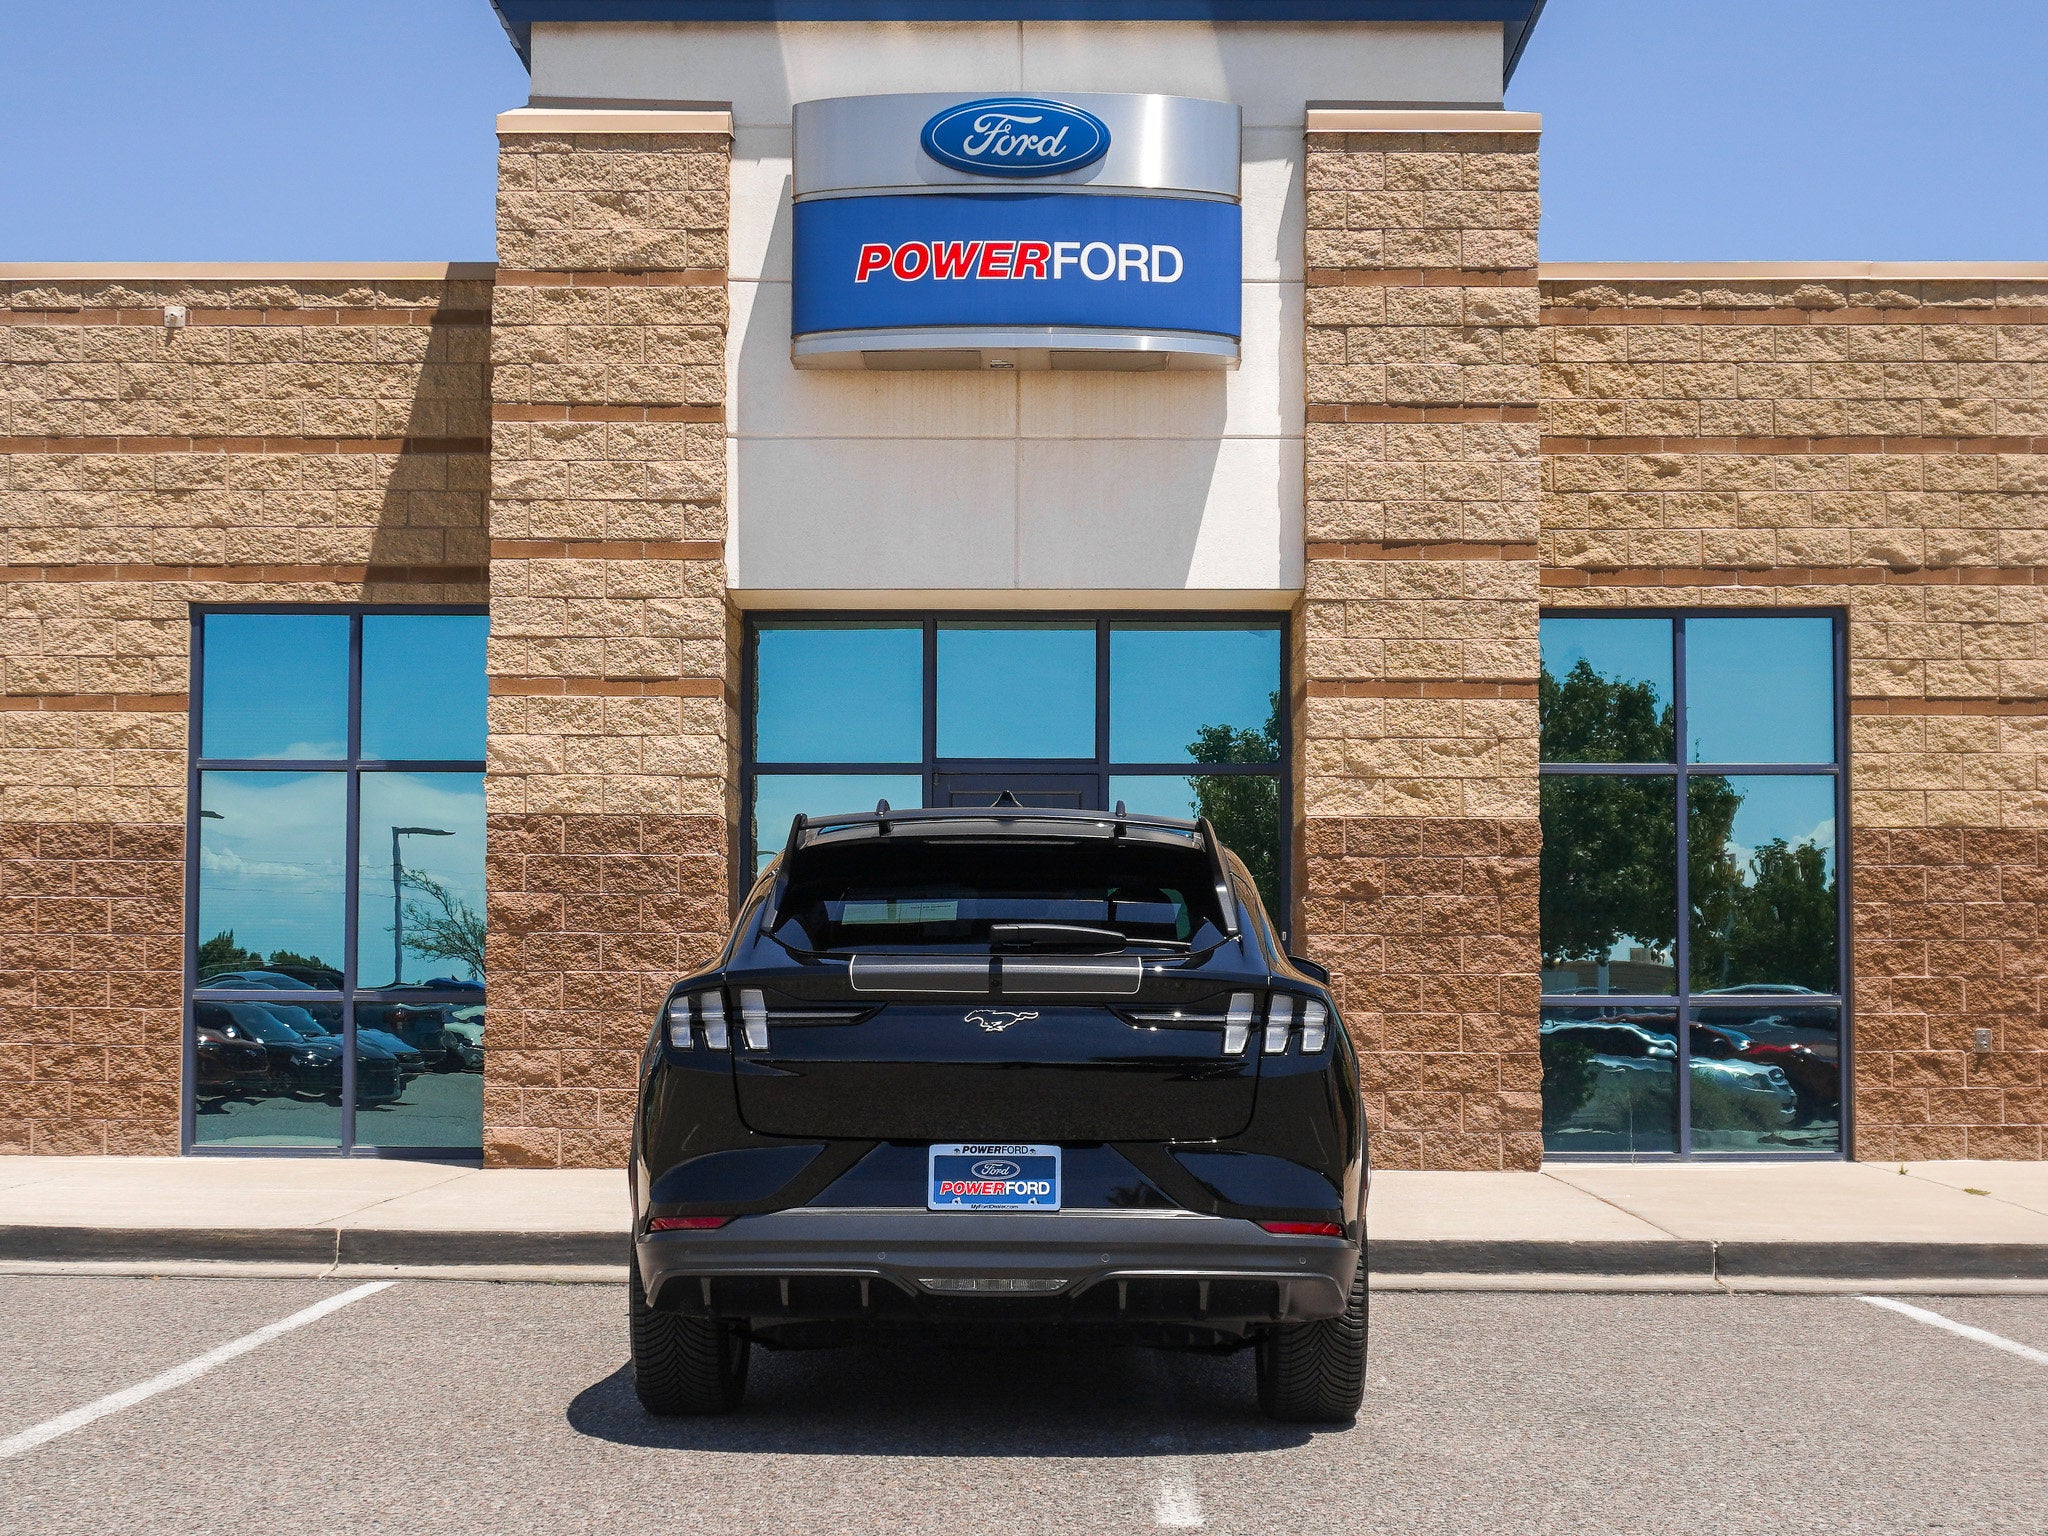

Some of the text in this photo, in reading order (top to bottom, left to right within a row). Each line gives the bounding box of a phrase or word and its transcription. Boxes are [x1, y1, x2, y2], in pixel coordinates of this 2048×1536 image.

[963, 113, 1069, 157] Ford
[855, 240, 1184, 283] POWERFORD
[962, 1145, 1029, 1155] POWERFORD
[981, 1163, 1010, 1176] Ford
[940, 1180, 1050, 1195] POWERFORD
